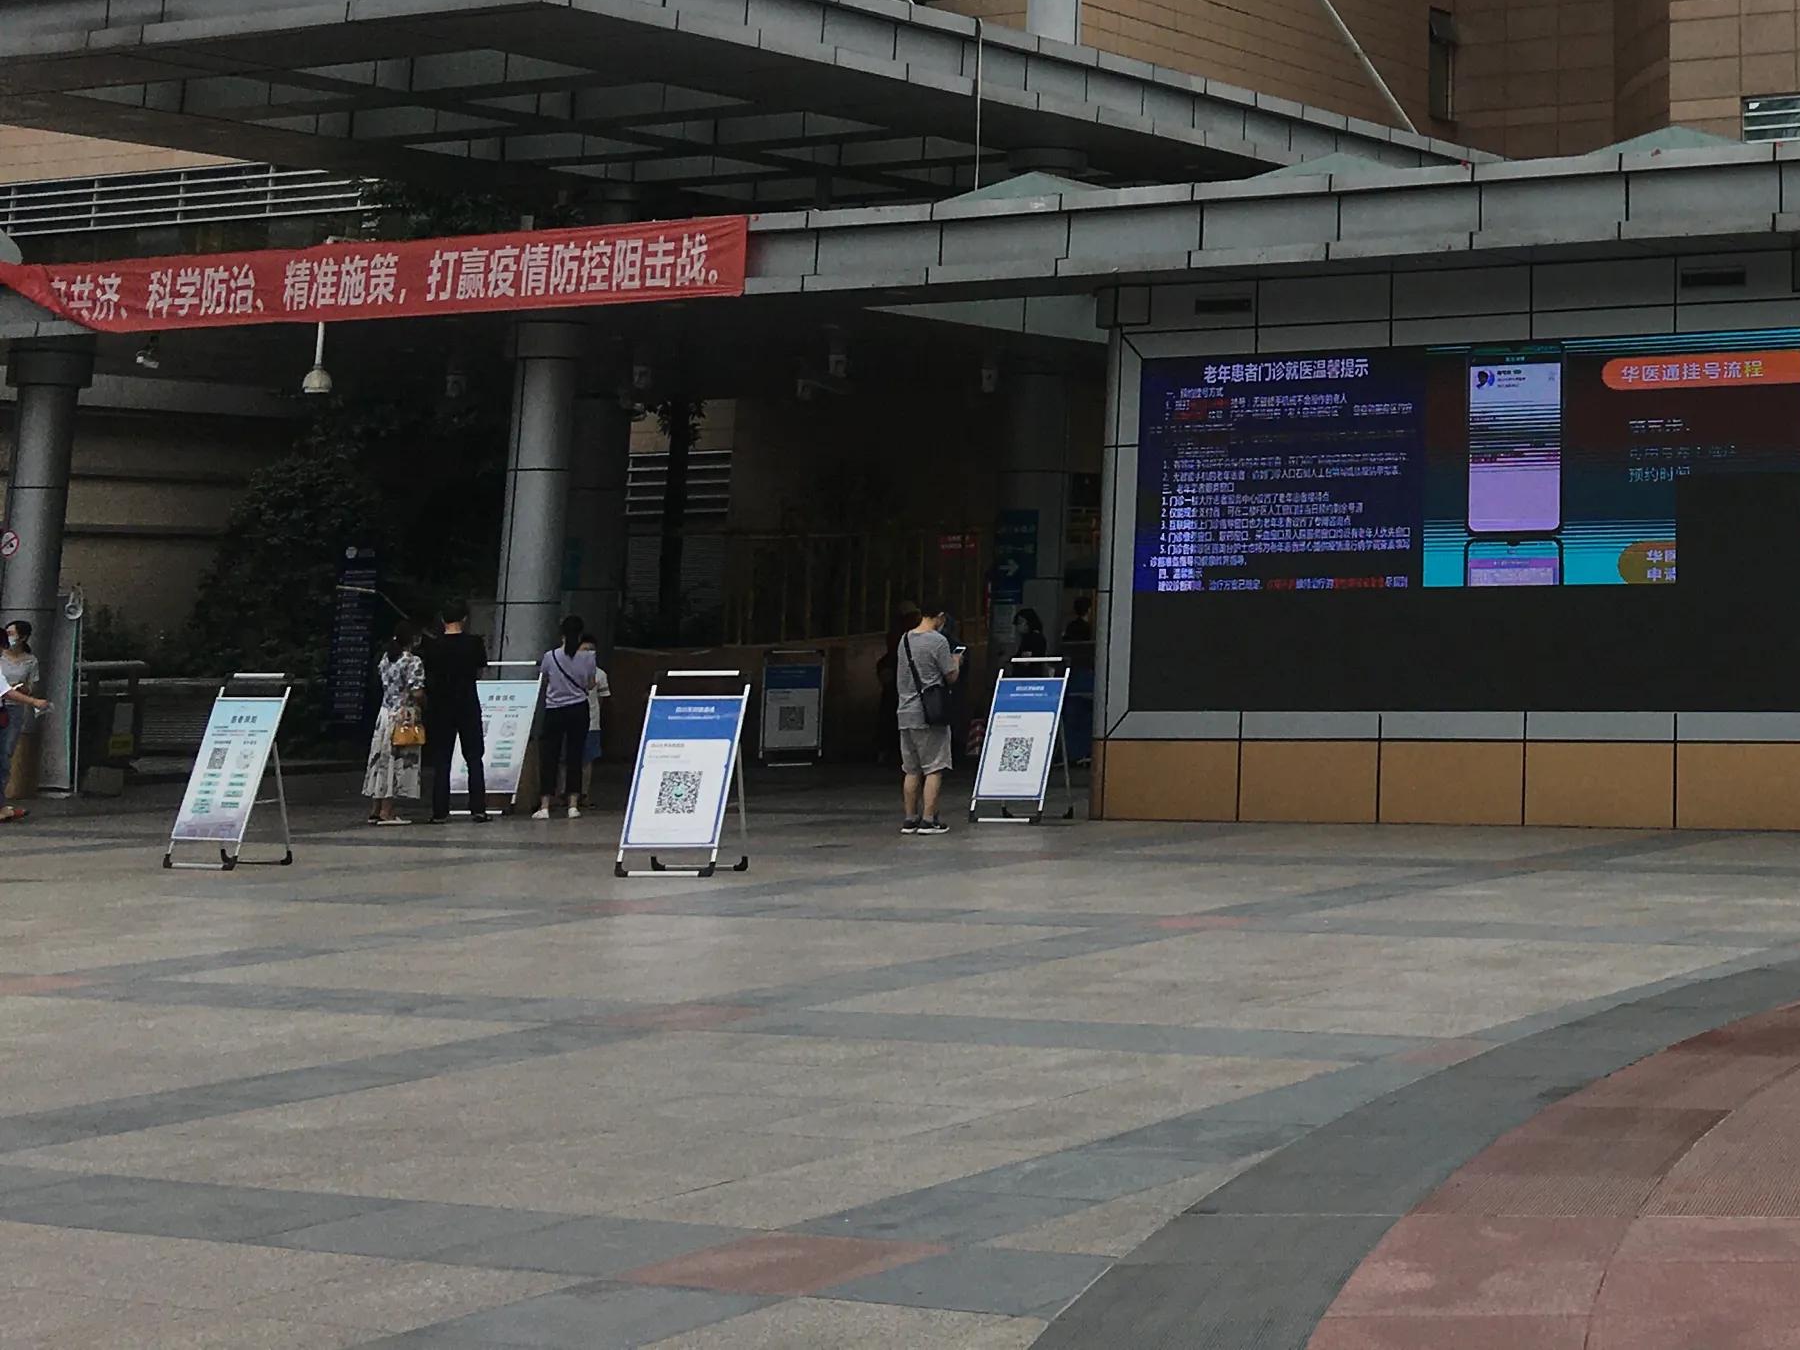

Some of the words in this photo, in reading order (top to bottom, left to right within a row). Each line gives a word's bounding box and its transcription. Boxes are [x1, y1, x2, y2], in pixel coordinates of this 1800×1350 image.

[1204, 359, 1369, 384] 老年患者门诊就医温馨提示
[1621, 361, 1764, 382] 华医通挂号流程
